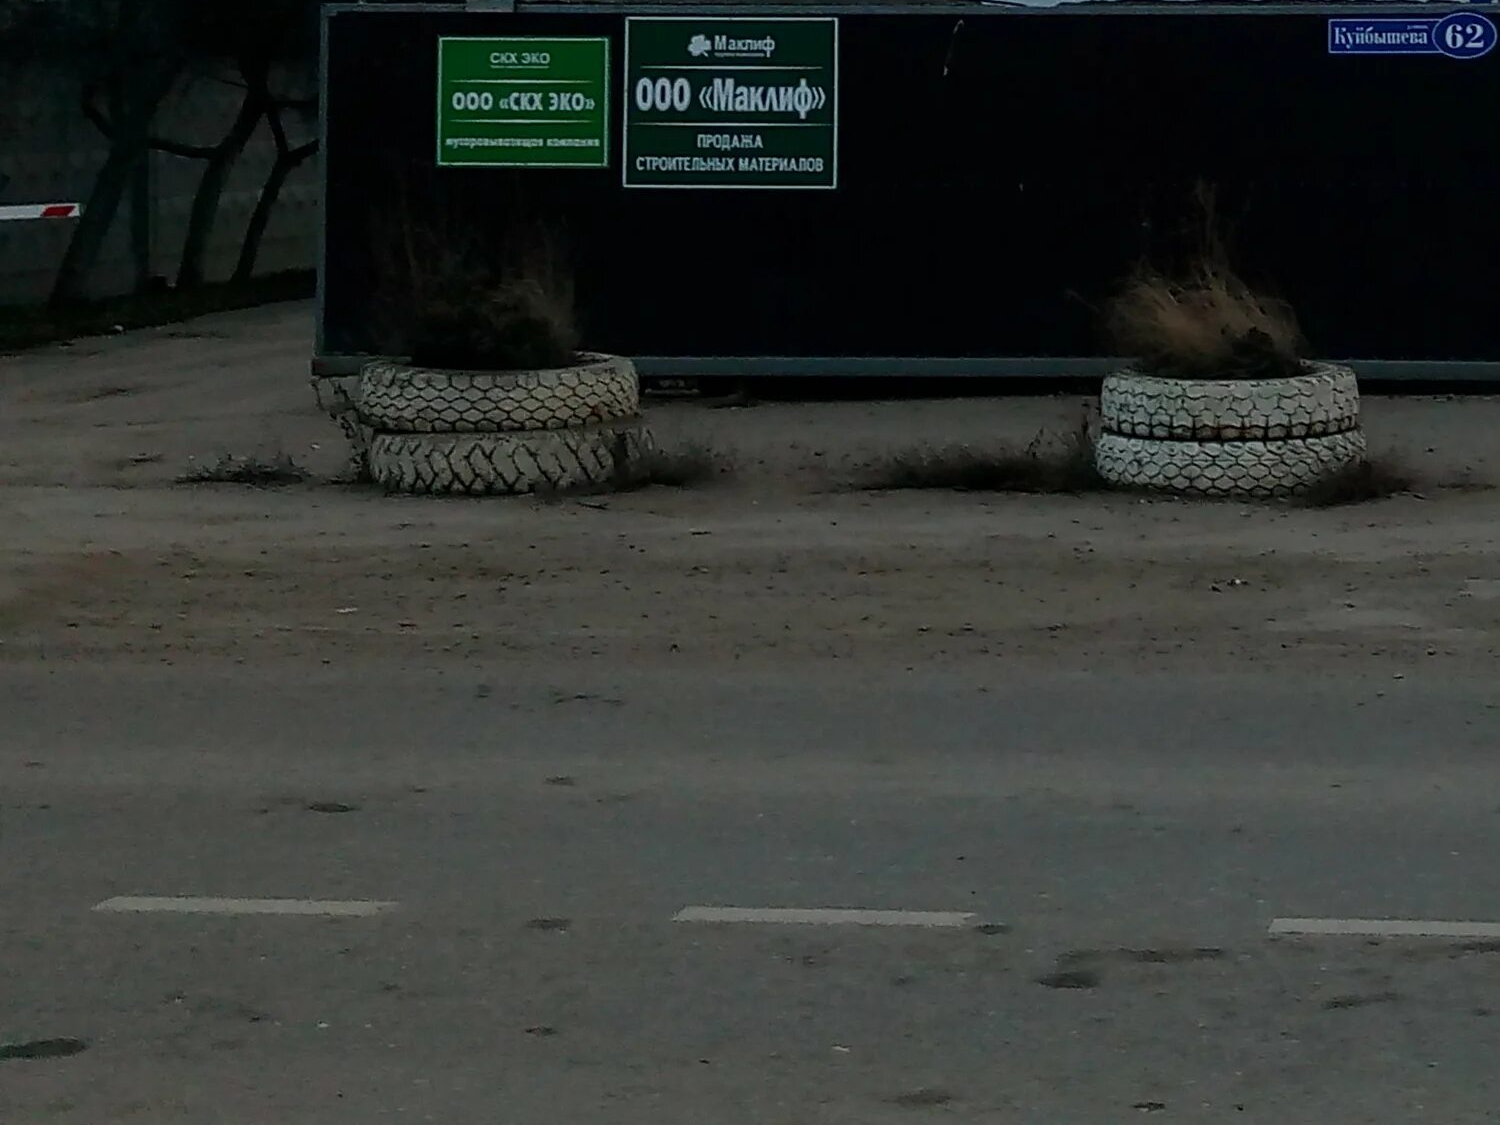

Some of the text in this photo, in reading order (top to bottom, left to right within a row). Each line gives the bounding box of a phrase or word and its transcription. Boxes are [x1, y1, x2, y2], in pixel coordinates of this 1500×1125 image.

[1334, 23, 1485, 49] Куйбышева 62
[714, 35, 775, 58] Маклиф
[490, 52, 550, 64] СКХ ЭКО
[452, 92, 595, 111] ООО «СКХ ЭКО»
[636, 77, 826, 119] ООО «Маклиф»
[697, 134, 763, 150] ПРОДАЖА
[636, 156, 824, 172] СТРОИТЕЛЬНЫХ МАТЕРИАЛОВ
